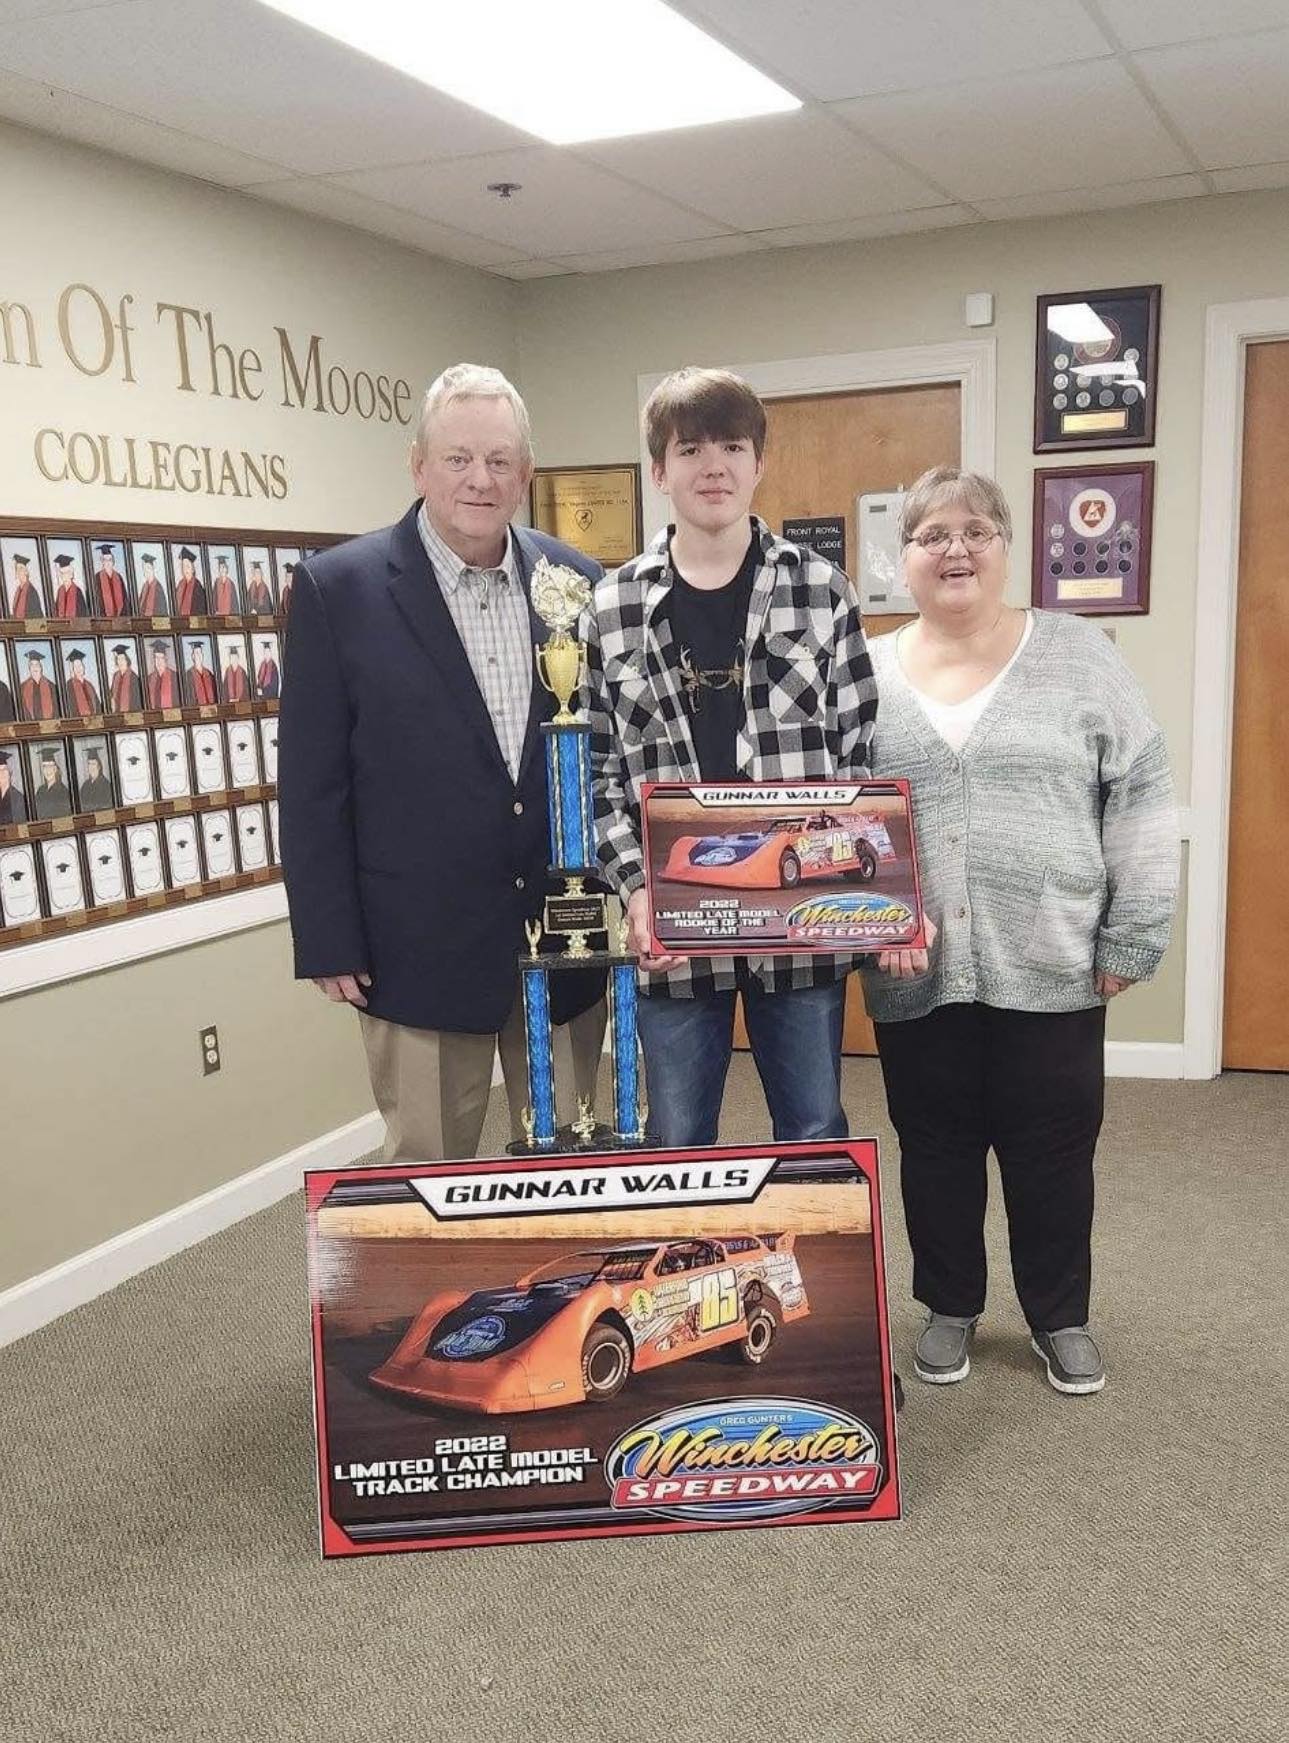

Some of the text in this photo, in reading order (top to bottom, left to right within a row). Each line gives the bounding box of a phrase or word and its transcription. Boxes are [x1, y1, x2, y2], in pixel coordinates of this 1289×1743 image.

[58, 283, 137, 383] Of
[156, 302, 264, 401] The
[273, 326, 412, 426] Moose
[33, 428, 290, 500] COLLEGIANS
[786, 526, 840, 536] FRONT ROYAL
[817, 541, 842, 549] LODGE
[703, 789, 846, 800] GUNNAR WALLS
[700, 900, 740, 909] 2022
[656, 909, 780, 919] LIMITED LATE MODEL
[790, 905, 911, 927] Winchester
[674, 918, 765, 928] ROOKIE OF THE
[704, 926, 738, 935] YEAR
[796, 926, 908, 936] SPEEDWAY
[445, 1168, 750, 1204] GUNNAR WALLS
[719, 1417, 745, 1426] GREG
[435, 1435, 507, 1455] 2022
[620, 1425, 873, 1478] Winchester
[334, 1447, 598, 1480] LIMITED LATE MODEL
[352, 1466, 583, 1497] TRACK CHAMPION
[626, 1471, 869, 1500] SPEEDWAY
